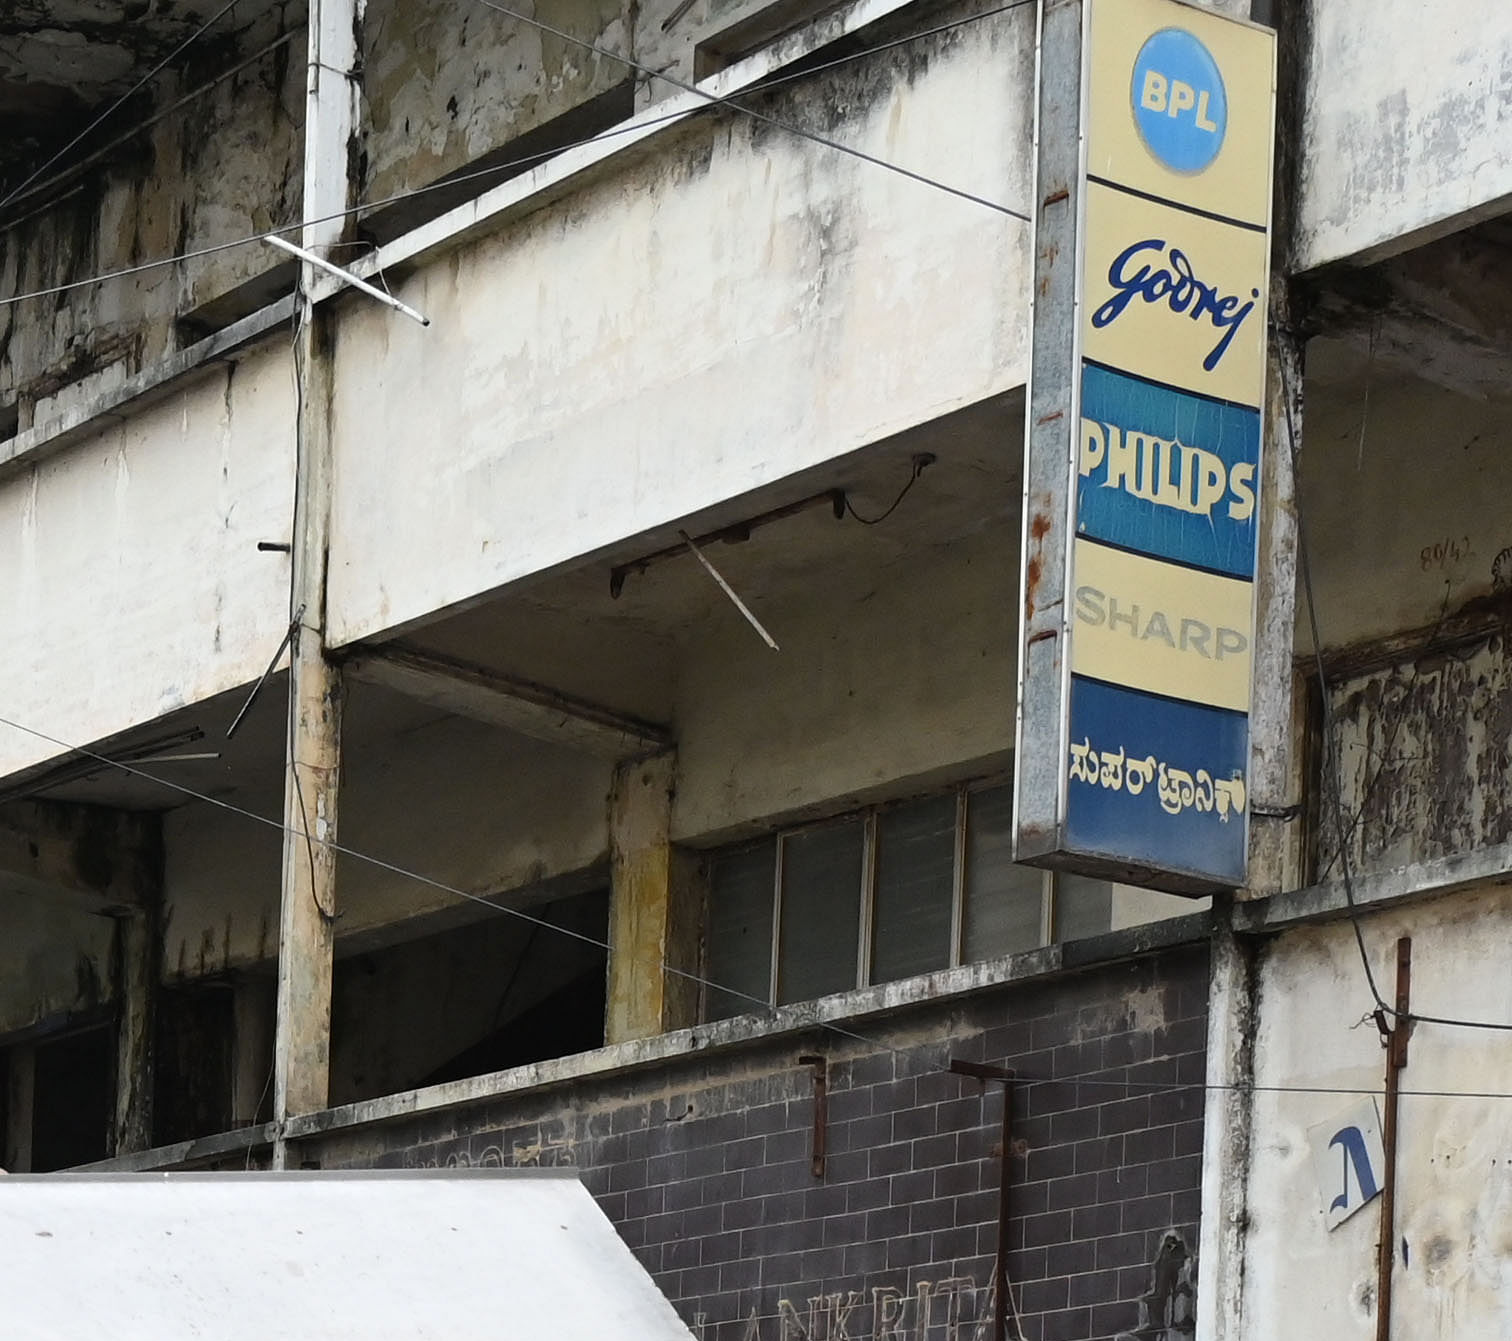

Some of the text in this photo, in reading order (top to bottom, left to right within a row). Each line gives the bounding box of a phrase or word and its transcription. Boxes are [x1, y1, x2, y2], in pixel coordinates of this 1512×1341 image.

[1139, 68, 1219, 134] BPL
[1091, 237, 1259, 372] Godrej
[1078, 417, 1257, 522] PHILIPS
[1075, 585, 1249, 663] SHARP
